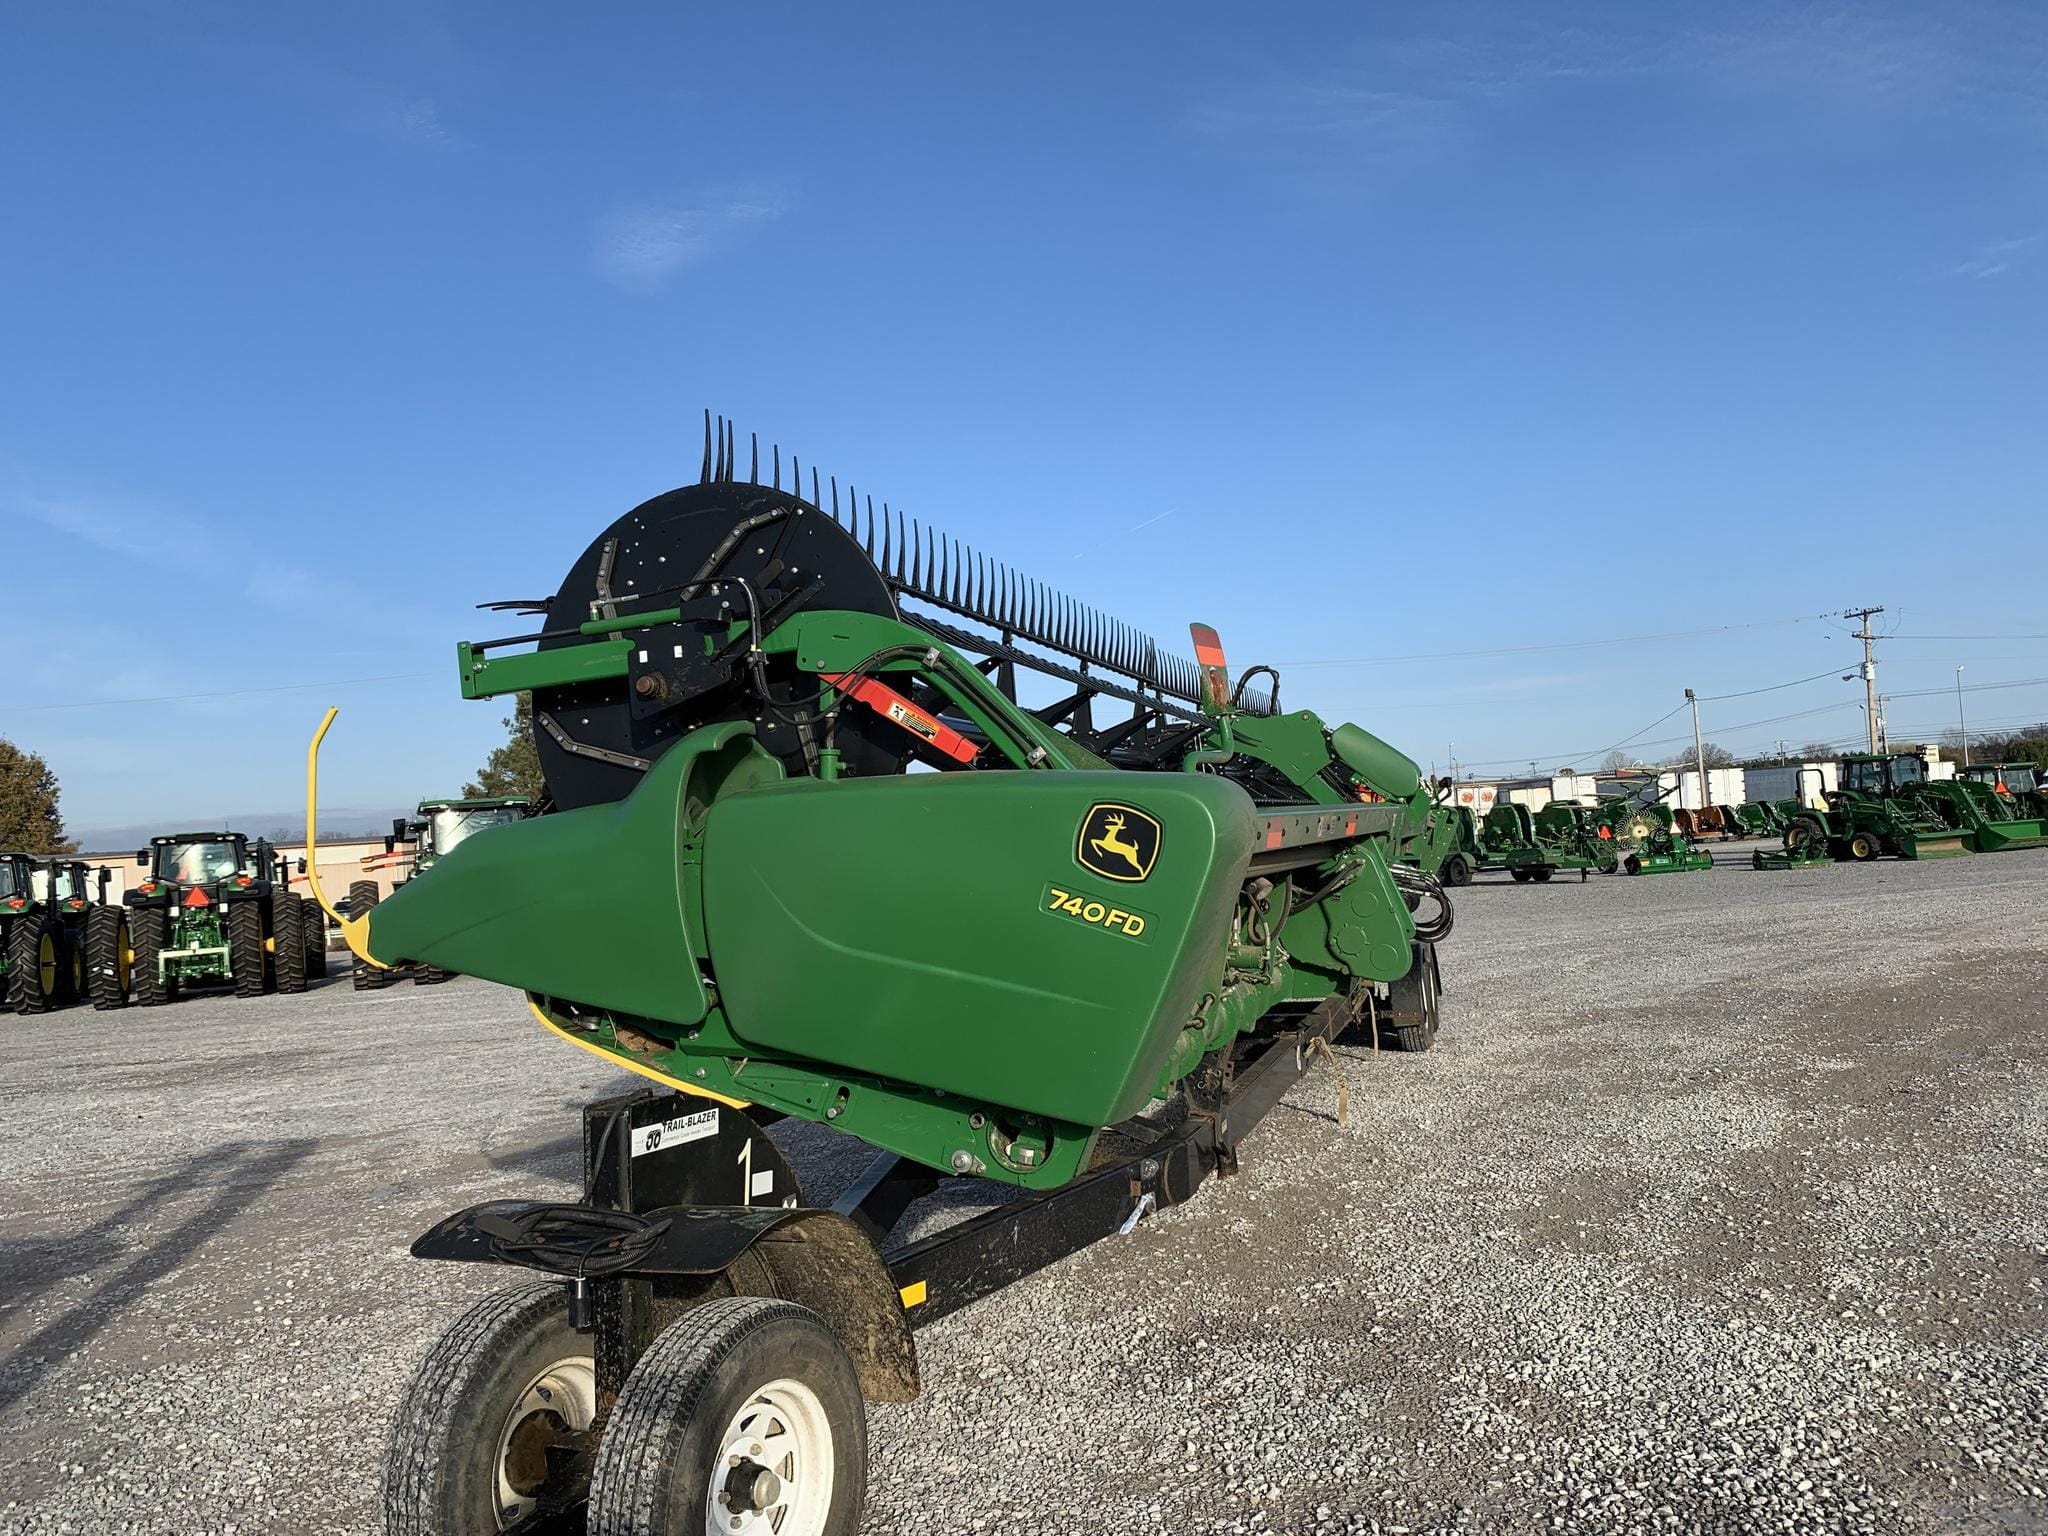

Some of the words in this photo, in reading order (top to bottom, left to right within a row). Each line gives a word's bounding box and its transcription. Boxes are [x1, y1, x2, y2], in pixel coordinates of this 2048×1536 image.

[1049, 888, 1146, 936] 740FD
[662, 1110, 717, 1133] TRAIL-BLAZER
[737, 1137, 752, 1206] 1
